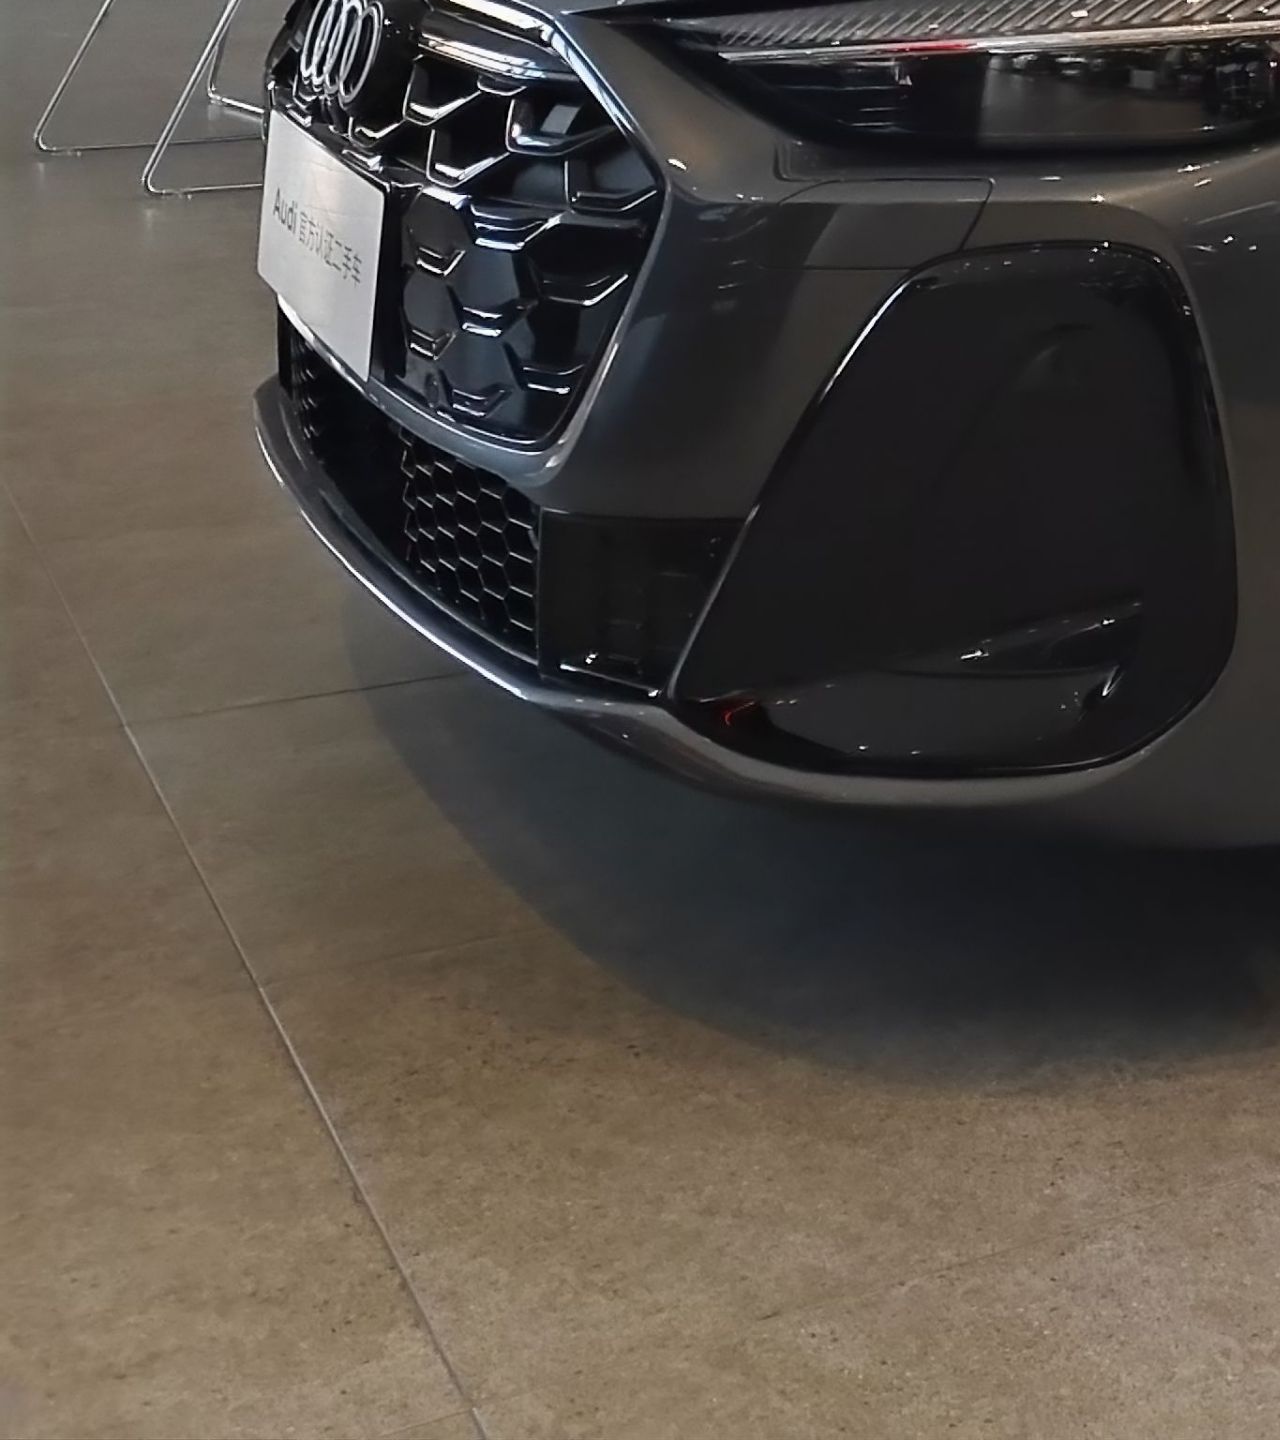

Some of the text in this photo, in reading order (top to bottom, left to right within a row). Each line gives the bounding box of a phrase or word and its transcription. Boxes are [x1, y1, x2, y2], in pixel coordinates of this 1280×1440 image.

[273, 187, 362, 288] Audi 官方认证二手车
